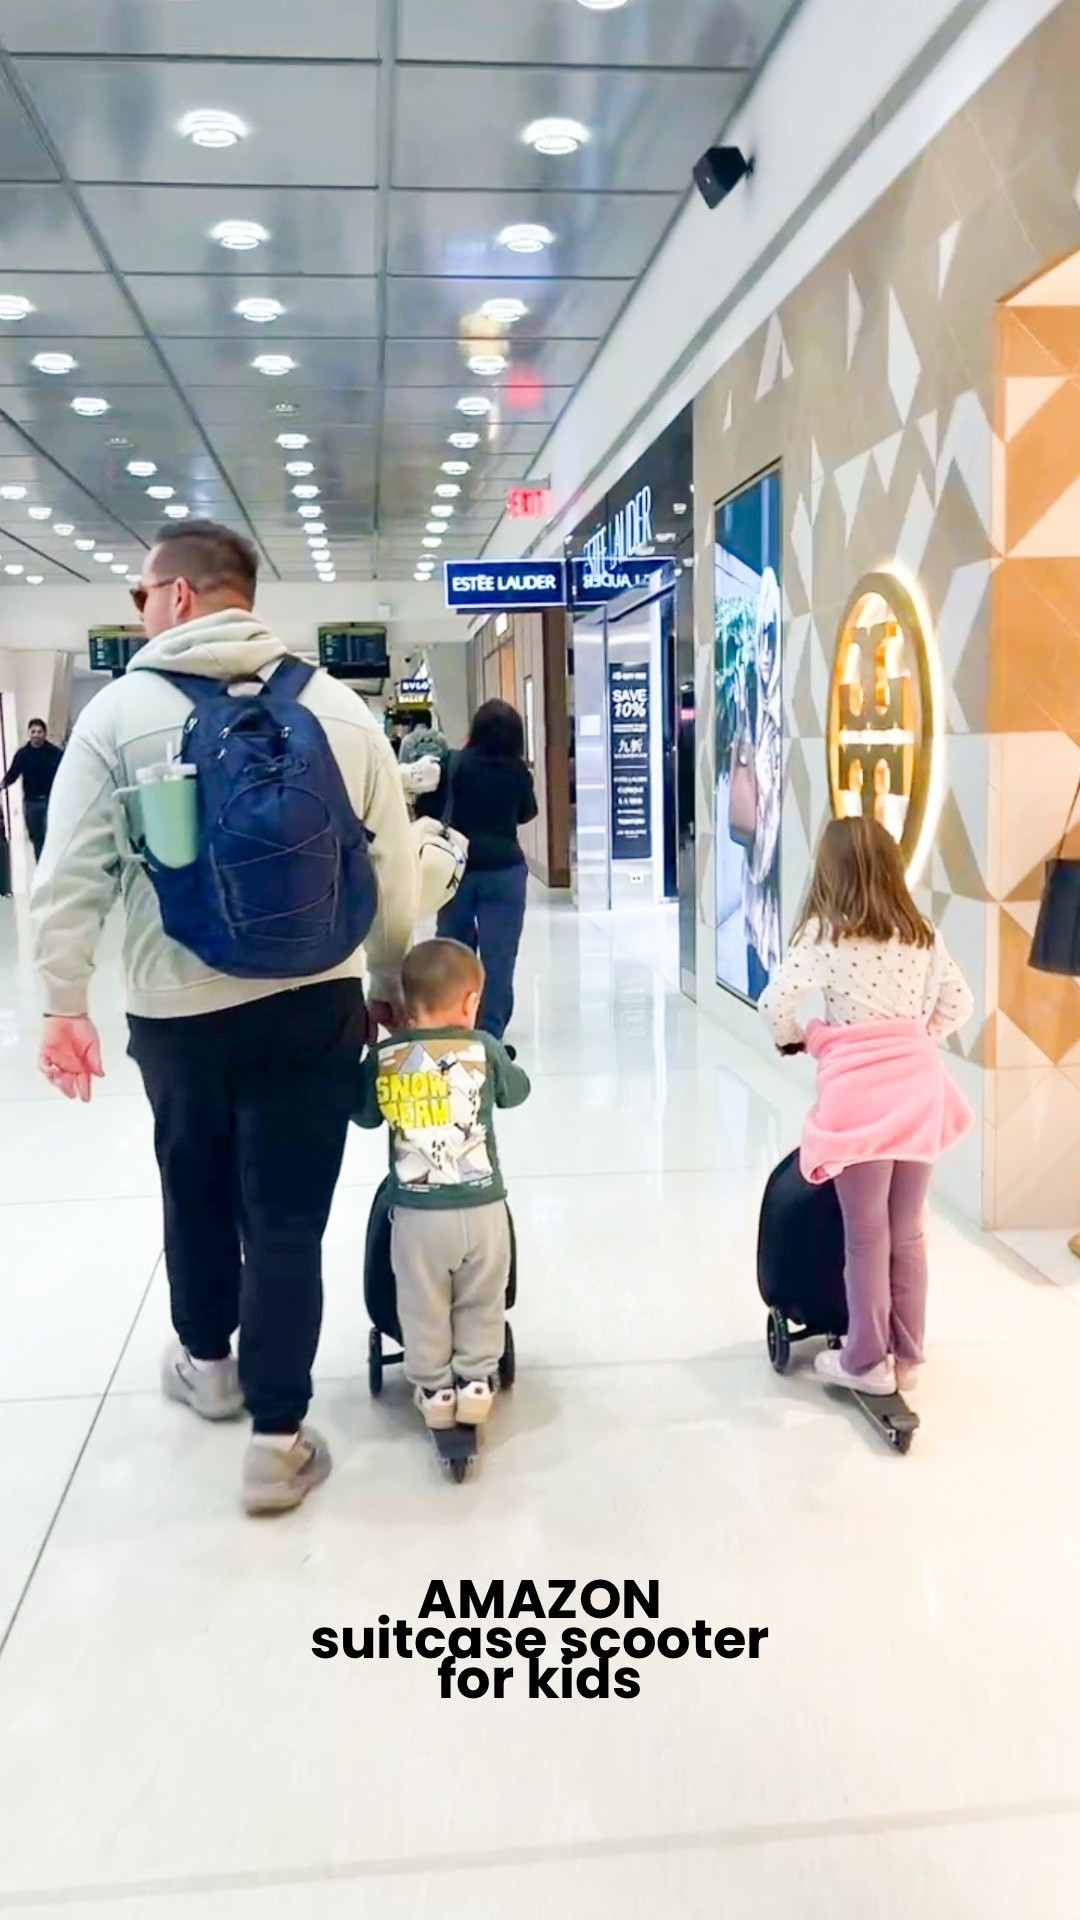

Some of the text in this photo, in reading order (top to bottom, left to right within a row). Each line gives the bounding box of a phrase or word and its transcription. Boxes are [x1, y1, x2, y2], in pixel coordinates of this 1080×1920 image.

[509, 489, 544, 518] EXIT
[497, 574, 556, 591] LAUDER
[612, 688, 648, 702] SAVE
[614, 701, 647, 718] 10%
[375, 1072, 449, 1104] SNOW
